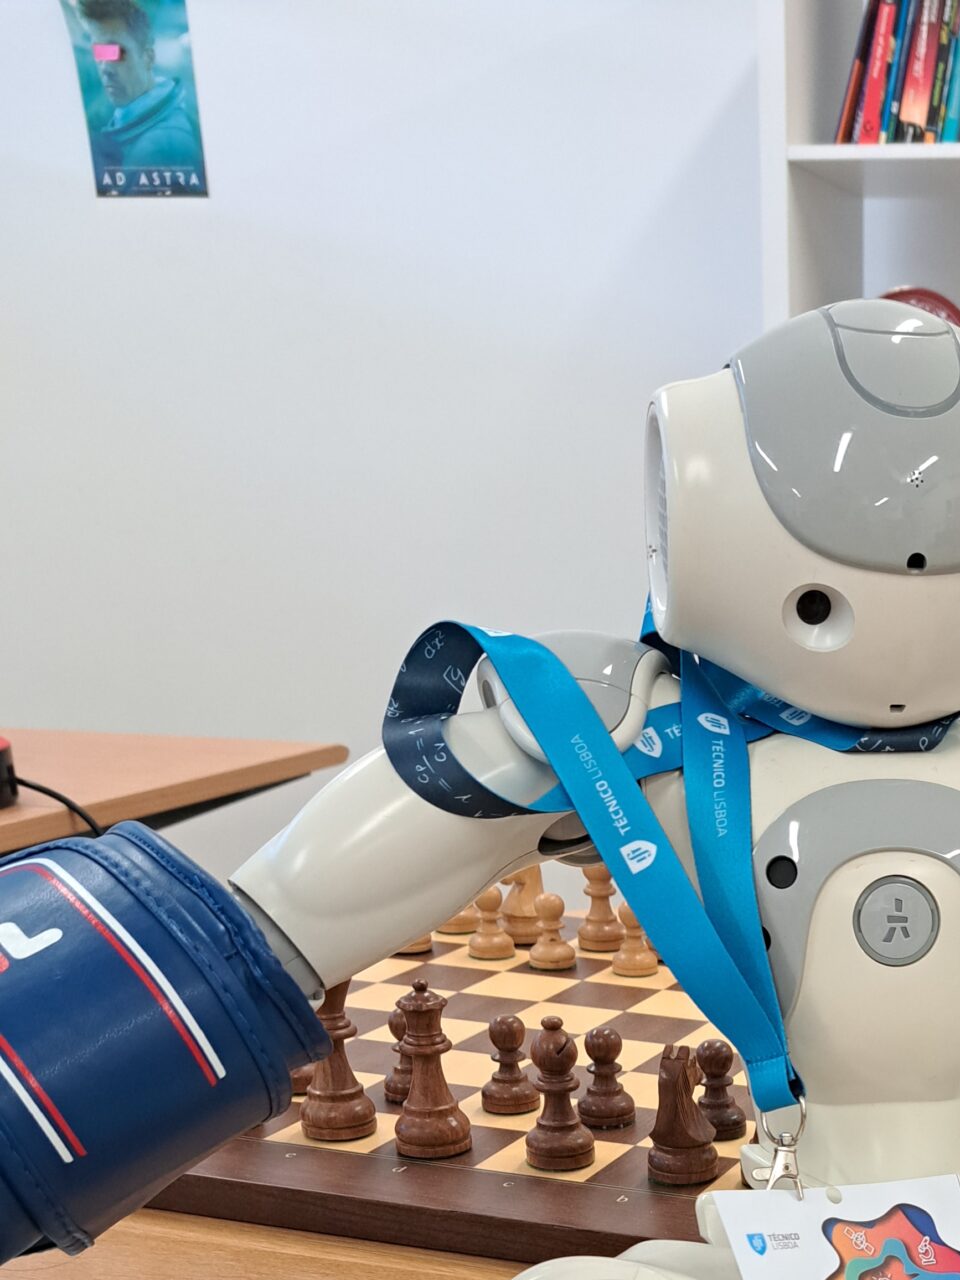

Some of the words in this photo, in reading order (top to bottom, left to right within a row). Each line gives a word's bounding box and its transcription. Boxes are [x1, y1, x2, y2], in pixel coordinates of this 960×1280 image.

[102, 171, 126, 186] AD
[139, 171, 200, 186] ASTRA
[570, 733, 603, 780] LISBOA
[711, 739, 727, 788] TÉCNICO
[595, 780, 632, 836] TÉCNICO
[713, 789, 728, 838] LISBOA
[768, 1232, 800, 1241] TÉCNICO
[772, 1241, 799, 1250] LISBOA
